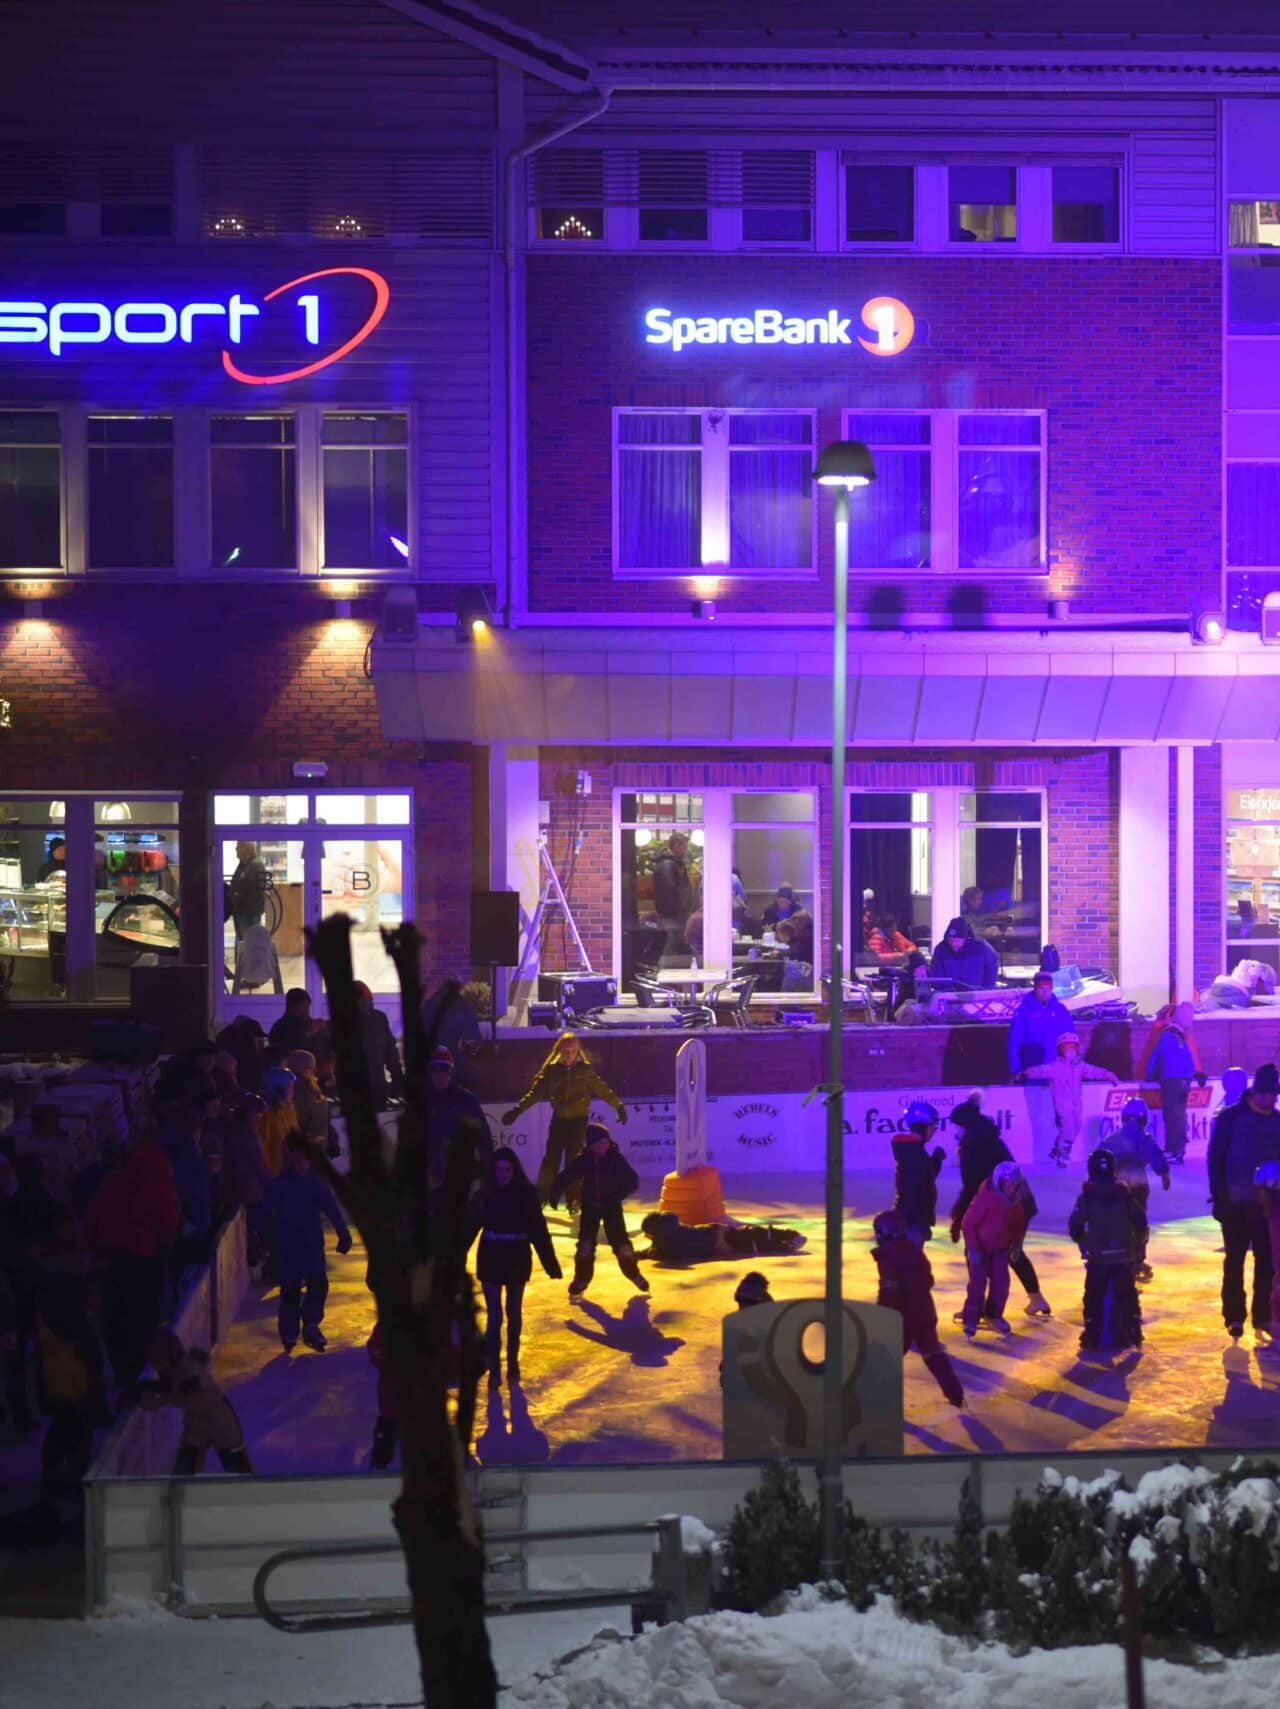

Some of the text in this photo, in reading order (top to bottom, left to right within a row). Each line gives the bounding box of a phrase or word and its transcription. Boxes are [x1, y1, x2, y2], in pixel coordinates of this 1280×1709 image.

[0, 294, 319, 356] sport 1
[645, 305, 896, 351] SpareBank 1
[352, 871, 371, 890] B
